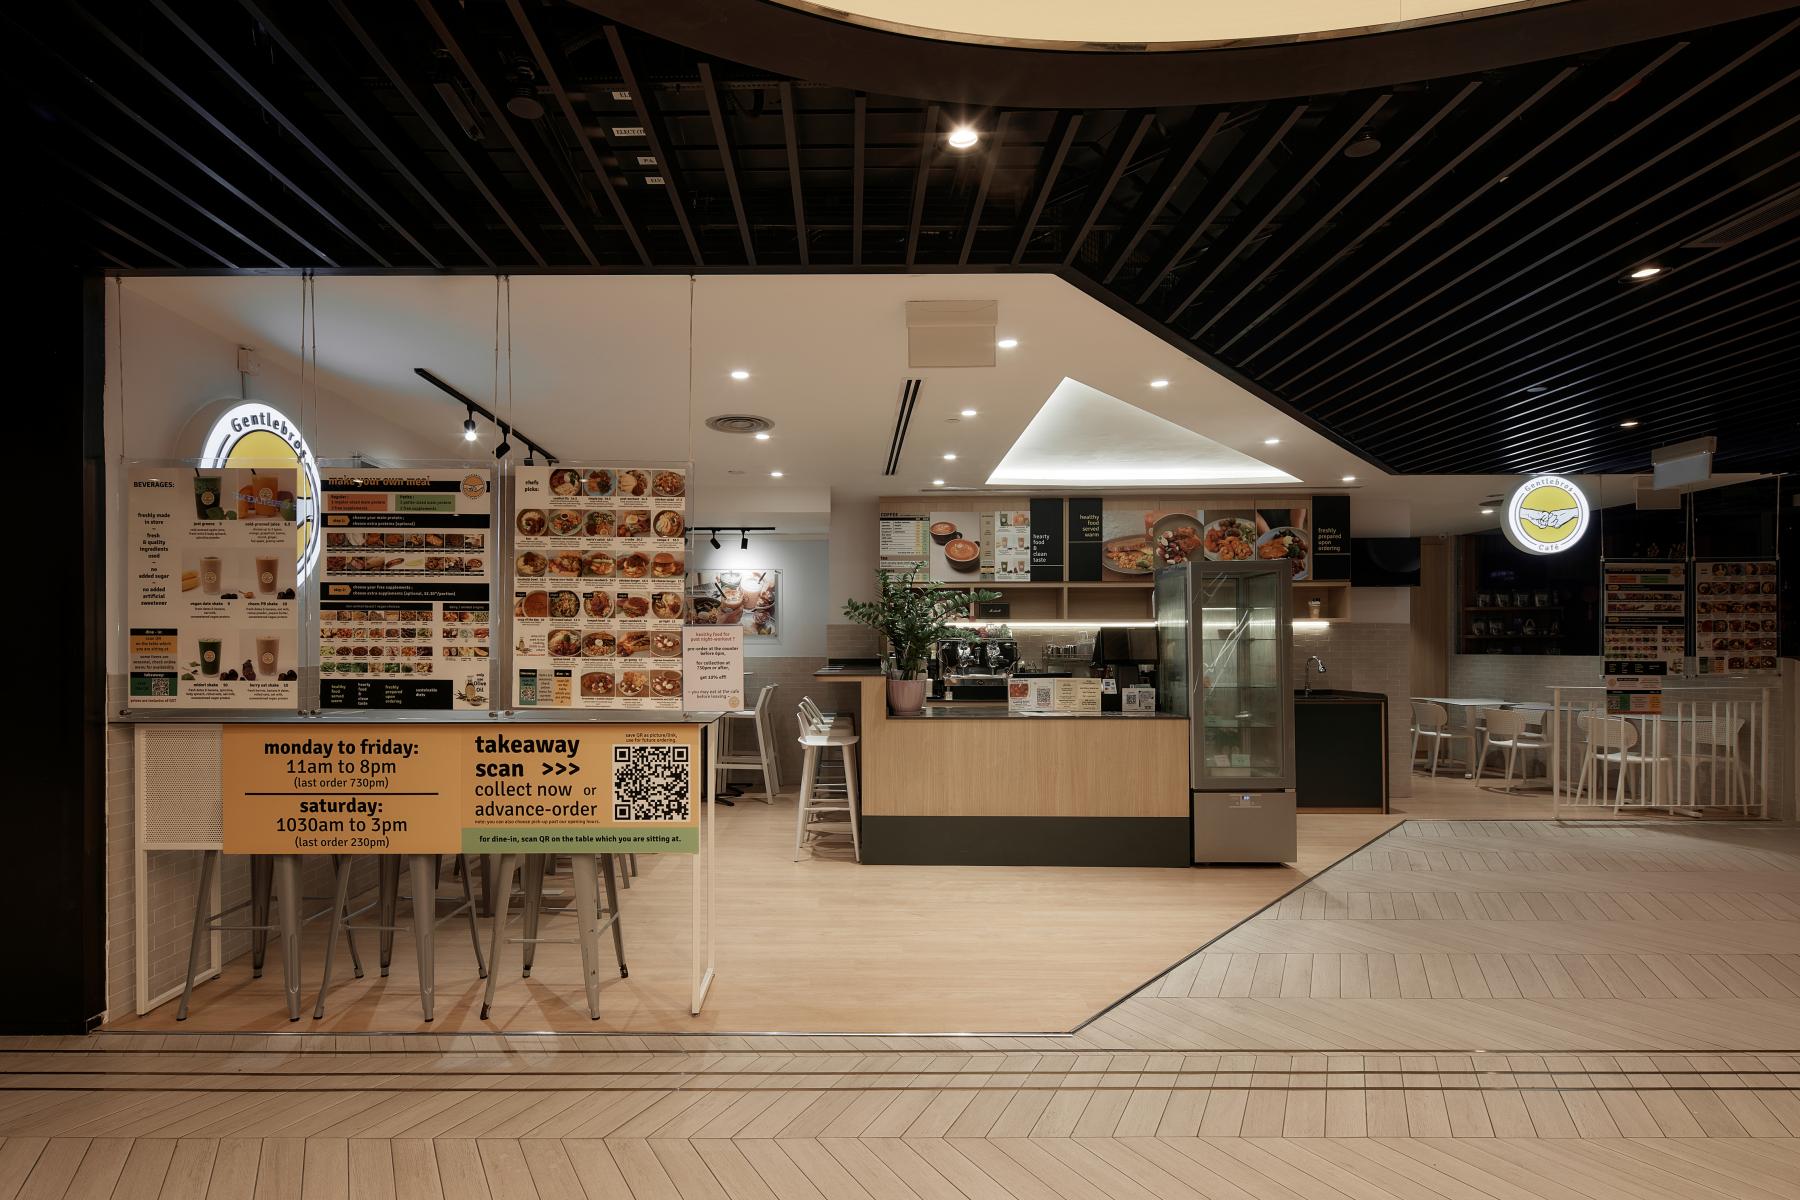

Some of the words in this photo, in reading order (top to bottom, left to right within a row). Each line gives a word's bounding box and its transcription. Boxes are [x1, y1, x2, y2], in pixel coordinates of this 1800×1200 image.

[230, 412, 307, 458] Gentlebros
[328, 475, 354, 486] make
[382, 477, 404, 486] own
[1524, 479, 1574, 492] Gentlebros
[1538, 543, 1560, 551] Café
[264, 738, 333, 758] monday
[337, 740, 355, 755] to
[359, 738, 419, 758] friday:
[474, 733, 580, 758] takeaway
[286, 760, 332, 774] 11am
[338, 761, 355, 774] to
[360, 760, 396, 777] 8pm
[475, 762, 524, 777] scan
[293, 776, 317, 788] (last
[319, 778, 348, 788] order
[350, 776, 389, 789] 730pm)
[475, 780, 532, 797] collect
[537, 784, 572, 797] now
[583, 785, 597, 797] or
[299, 797, 383, 816] saturday:
[475, 800, 598, 817] advance-order
[276, 817, 344, 832] 1030am
[349, 819, 366, 832] to
[371, 817, 408, 836] 3pm
[294, 836, 318, 848] (last
[320, 837, 348, 848] order
[350, 836, 389, 849] 230pm)
[479, 835, 490, 843] for
[491, 835, 520, 844] dine-in,
[539, 835, 550, 843] QR
[562, 835, 574, 843] the
[575, 835, 594, 843] table
[595, 835, 616, 843] which
[617, 837, 632, 845] you
[646, 835, 670, 845] sitting
